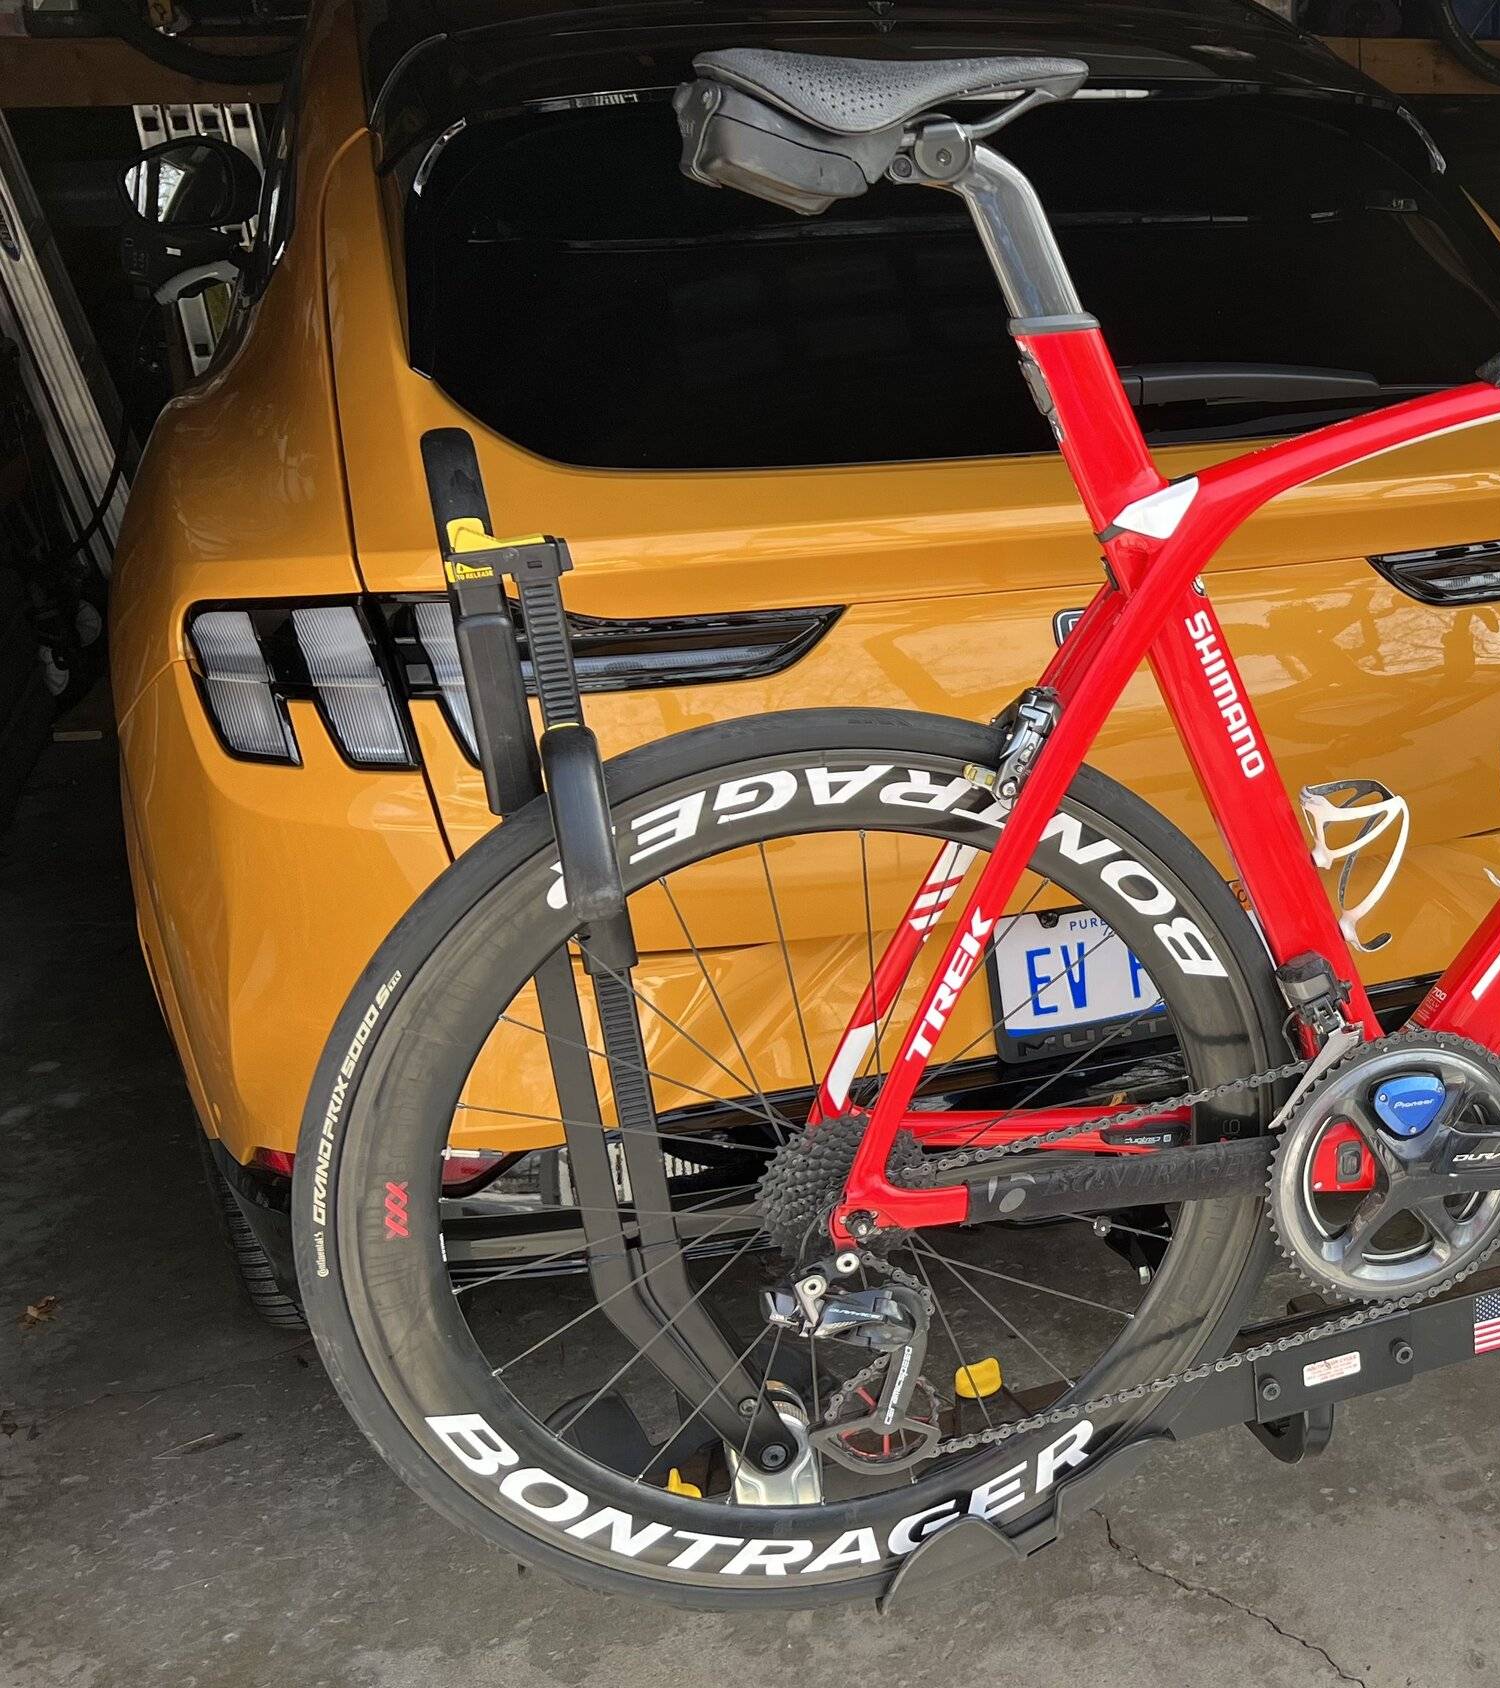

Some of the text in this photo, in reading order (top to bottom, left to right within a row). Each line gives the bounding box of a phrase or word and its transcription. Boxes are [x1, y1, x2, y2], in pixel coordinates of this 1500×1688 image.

[1184, 610, 1266, 779] SHIMANO
[905, 906, 993, 1062] TREK
[1025, 942, 1088, 1016] EV
[341, 1004, 380, 1080] 5000
[322, 1075, 350, 1140] PRIX
[1393, 1097, 1435, 1109] Pioneer
[312, 1138, 335, 1226] GRAND
[424, 1413, 1096, 1576] BONTRAGER
